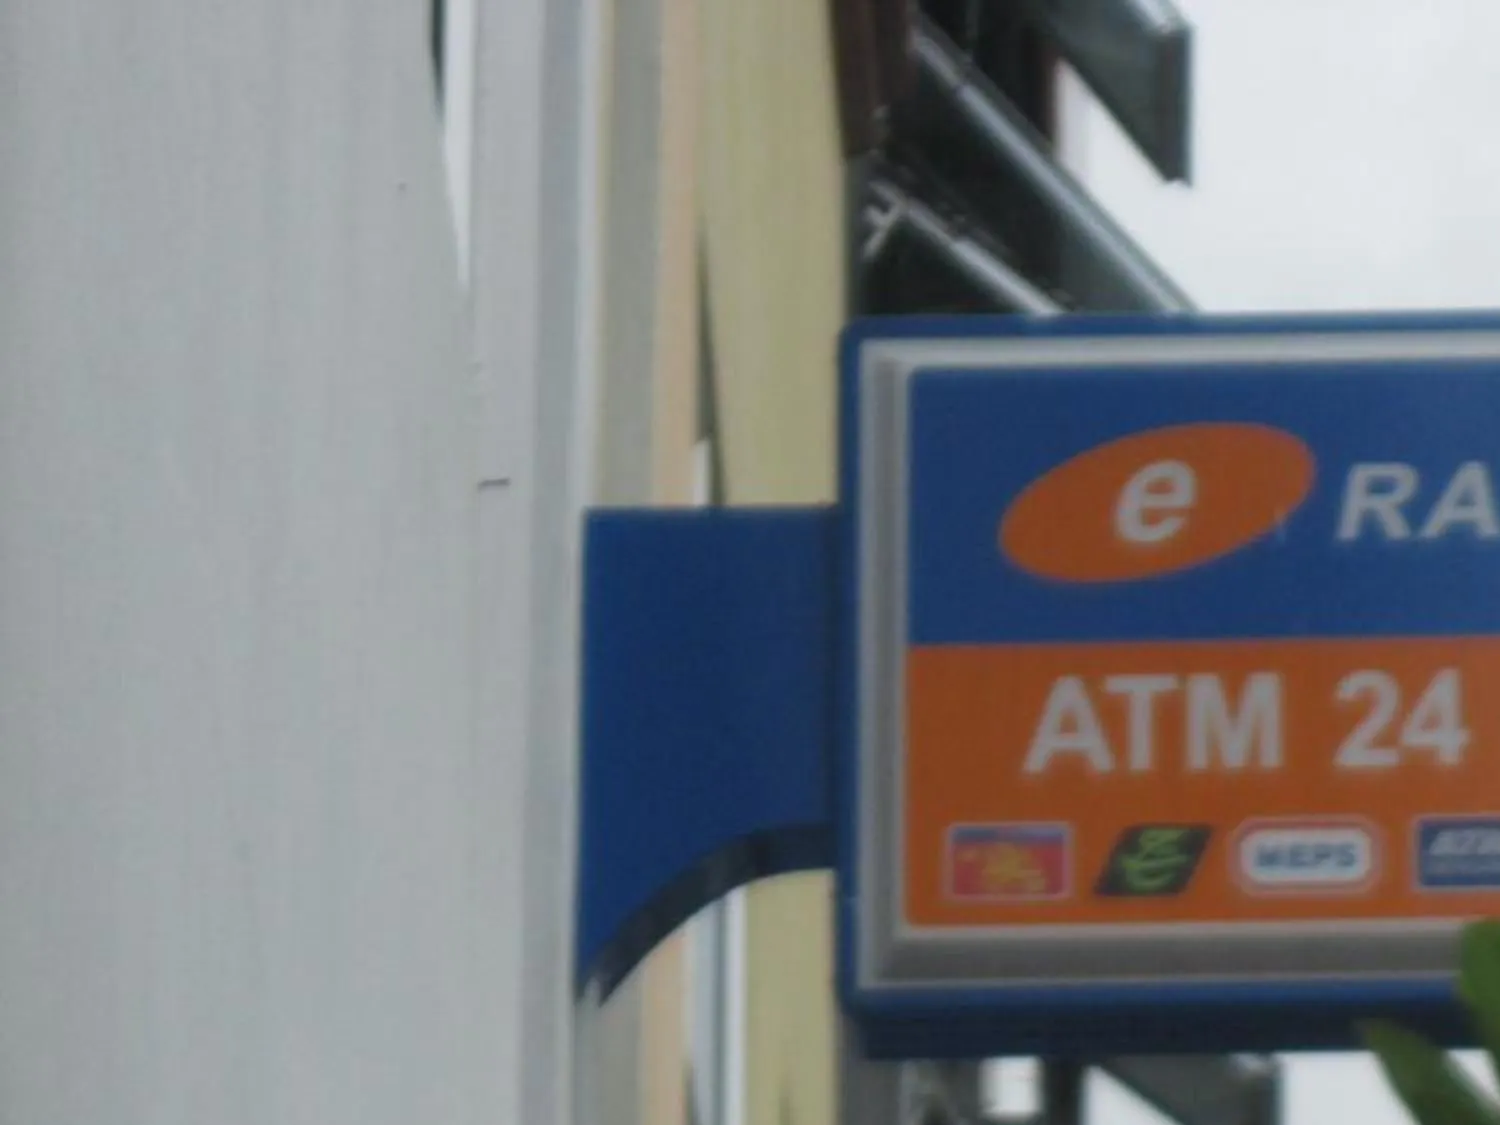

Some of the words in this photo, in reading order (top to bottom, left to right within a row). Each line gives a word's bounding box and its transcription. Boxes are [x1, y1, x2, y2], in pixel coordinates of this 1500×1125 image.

[1112, 457, 1198, 545] e
[1022, 671, 1284, 775] ATM
[1333, 667, 1470, 769] 24
[1255, 840, 1358, 870] MEPS
